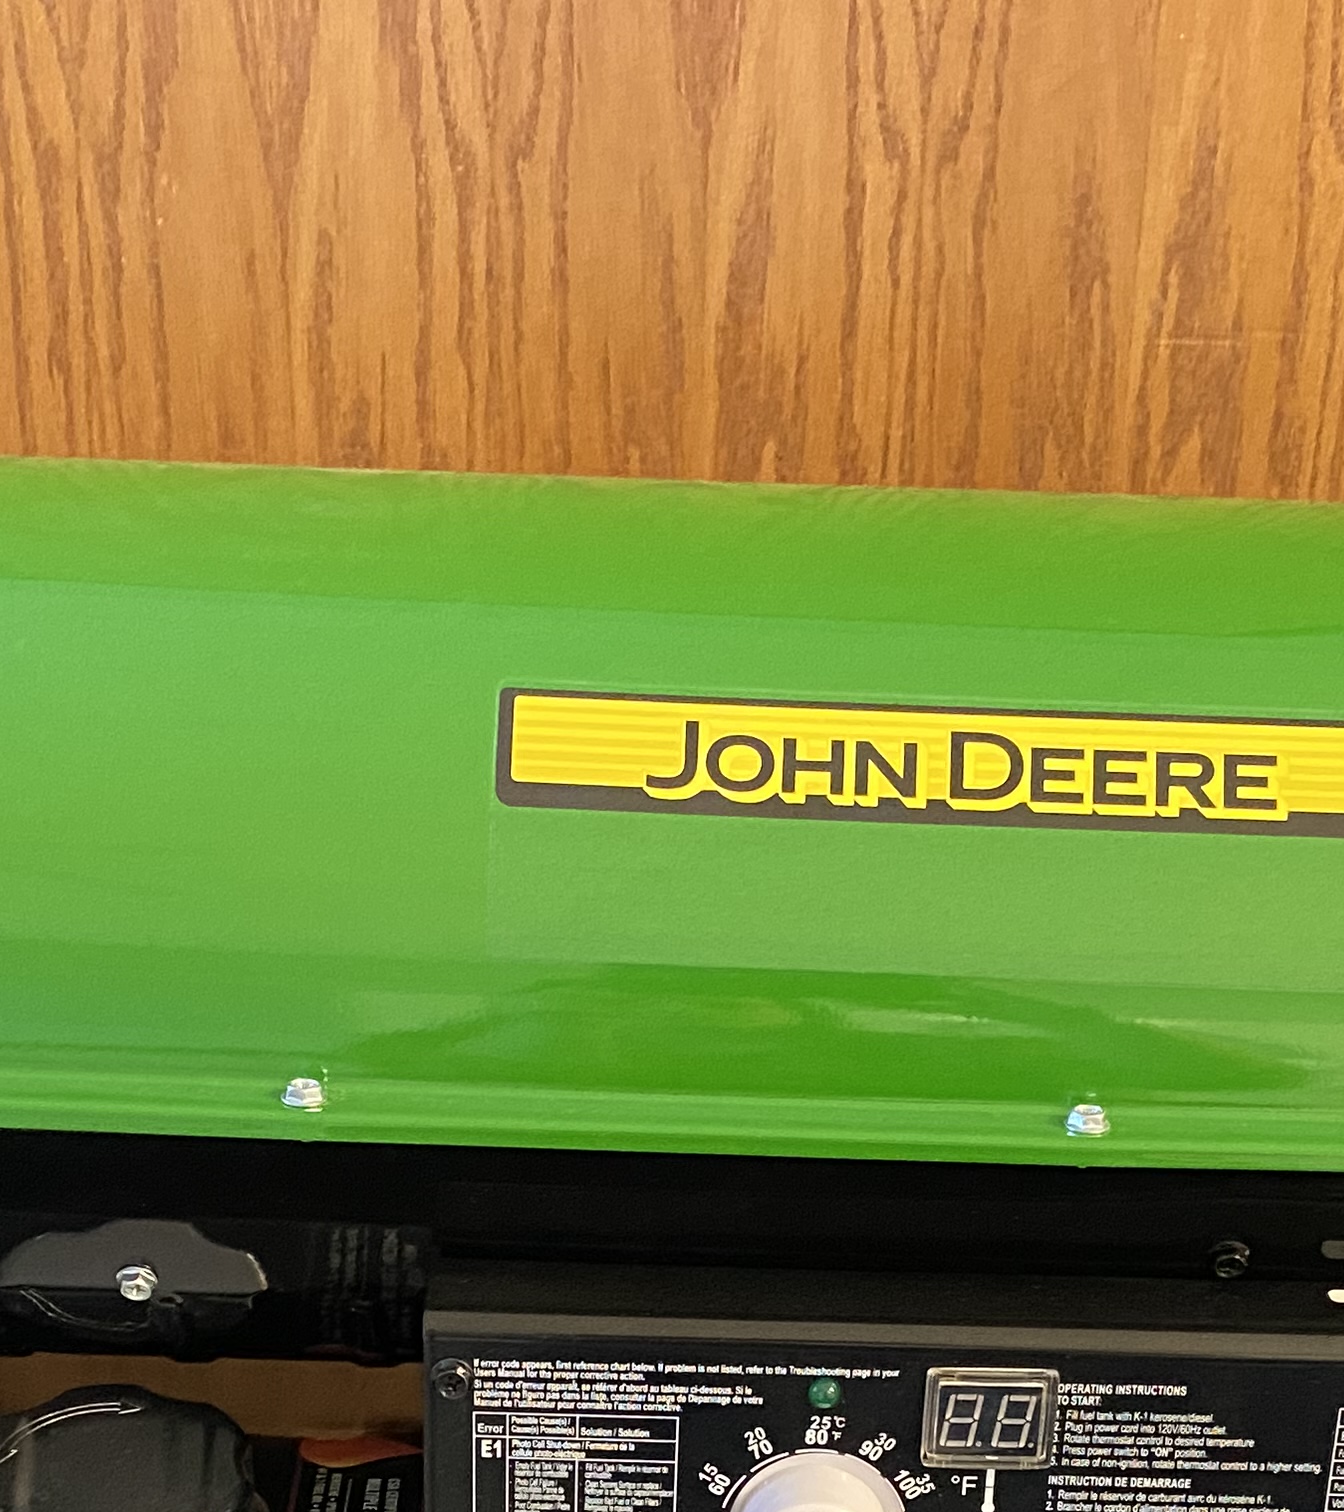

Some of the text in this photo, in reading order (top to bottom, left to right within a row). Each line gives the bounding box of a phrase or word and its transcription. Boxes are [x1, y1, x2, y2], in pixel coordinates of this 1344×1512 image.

[647, 720, 1279, 810] JOHN DEERE
[1058, 1383, 1187, 1396] OPERATING INSTRUCTIONS
[1058, 1396, 1102, 1406] TO START:
[1080, 1410, 1095, 1420] fuel
[477, 1423, 504, 1434] Error
[581, 1427, 612, 1436] Solution
[618, 1429, 650, 1438] Solution
[744, 1427, 766, 1445] 20
[1065, 1422, 1082, 1433] Plug
[1085, 1422, 1092, 1432] in
[1094, 1424, 1119, 1433] power
[1121, 1423, 1138, 1432] cord
[1140, 1424, 1155, 1433] into
[481, 1439, 502, 1458] E1
[748, 1442, 773, 1459] 70
[874, 1432, 896, 1451] 30
[859, 1441, 883, 1461] 90
[1063, 1445, 1085, 1455] Press
[1087, 1446, 1112, 1457] power
[1114, 1446, 1138, 1456] switch
[1141, 1447, 1148, 1456] to
[699, 1463, 718, 1482] 15
[708, 1474, 731, 1496] 60
[893, 1470, 921, 1500] 100
[915, 1474, 935, 1494] 35
[1048, 1475, 1192, 1489] INSTRUCTION DE DEMARRAGE
